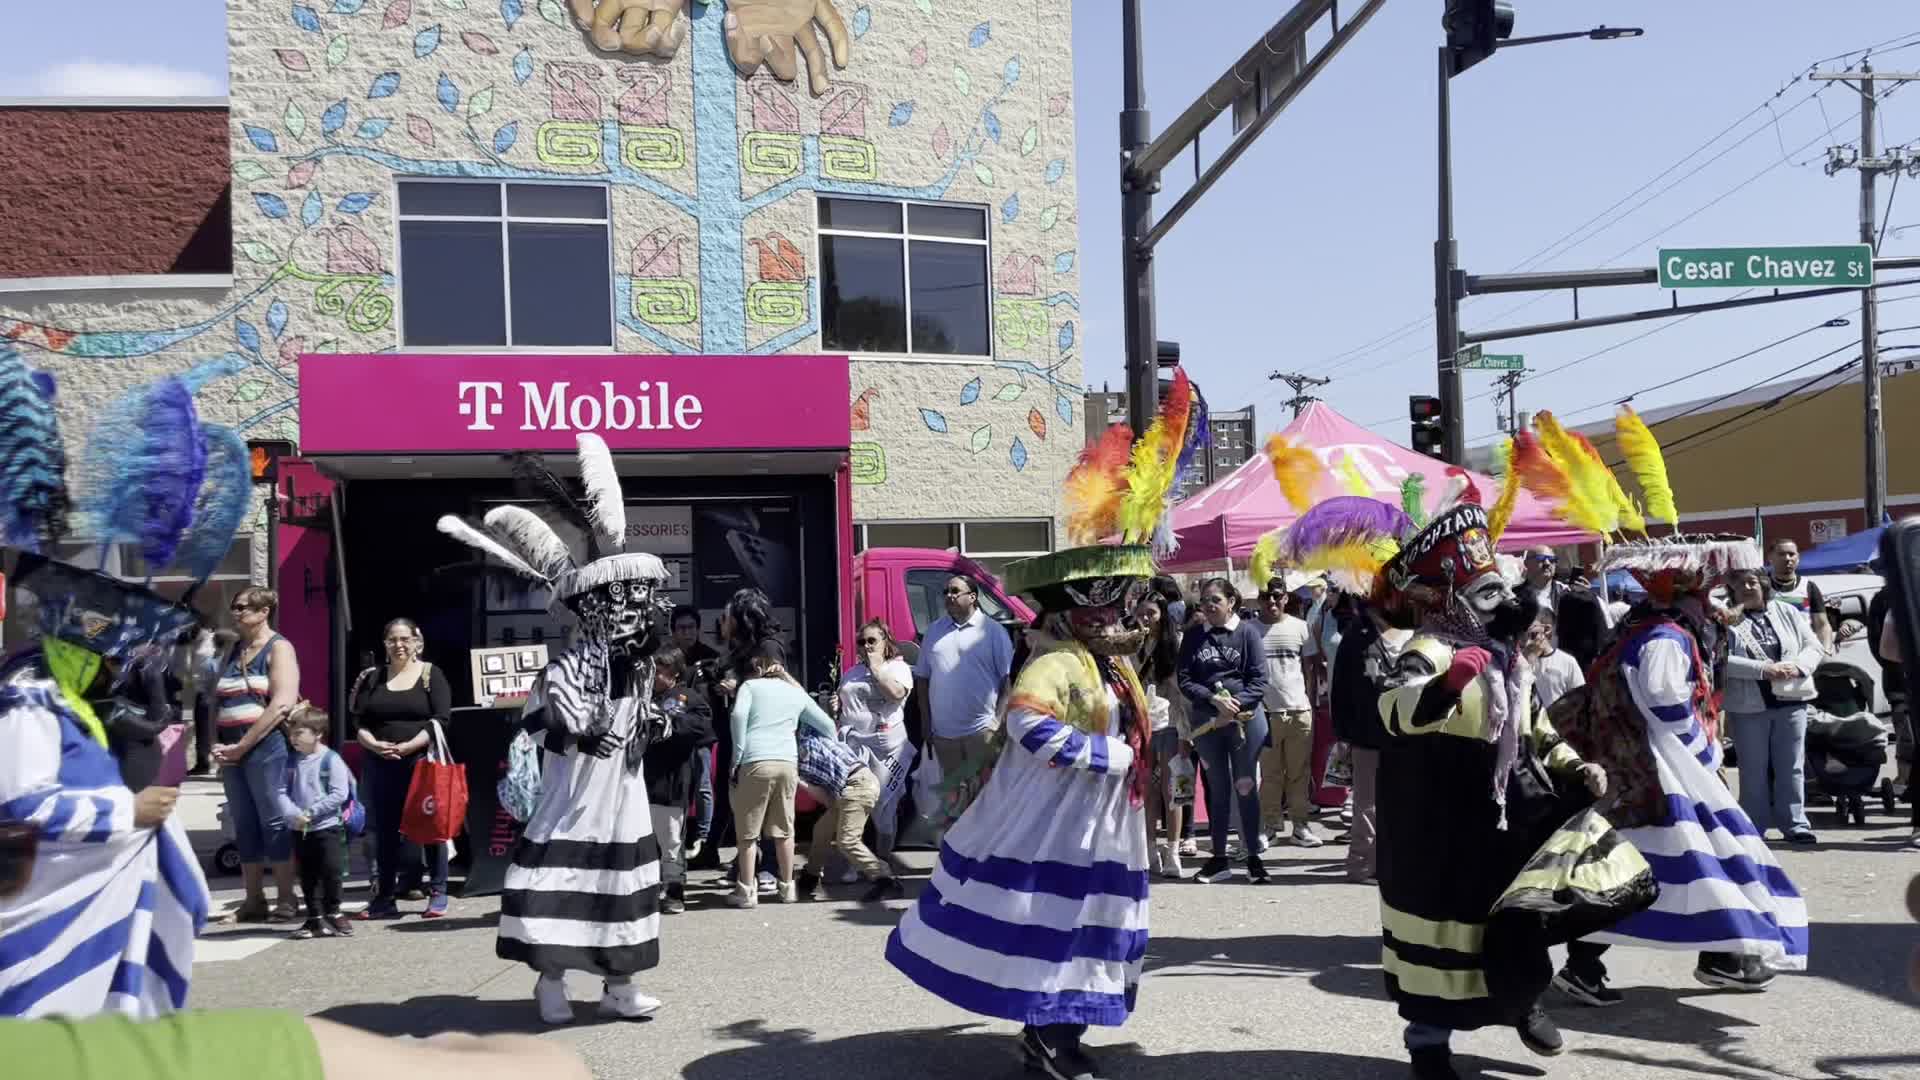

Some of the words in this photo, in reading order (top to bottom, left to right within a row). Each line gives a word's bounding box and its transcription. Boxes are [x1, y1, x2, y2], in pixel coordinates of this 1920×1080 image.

[1667, 256, 1734, 280] Cesar
[1746, 255, 1835, 279] Chavez
[1847, 261, 1864, 278] St
[519, 381, 703, 431] Mobile
